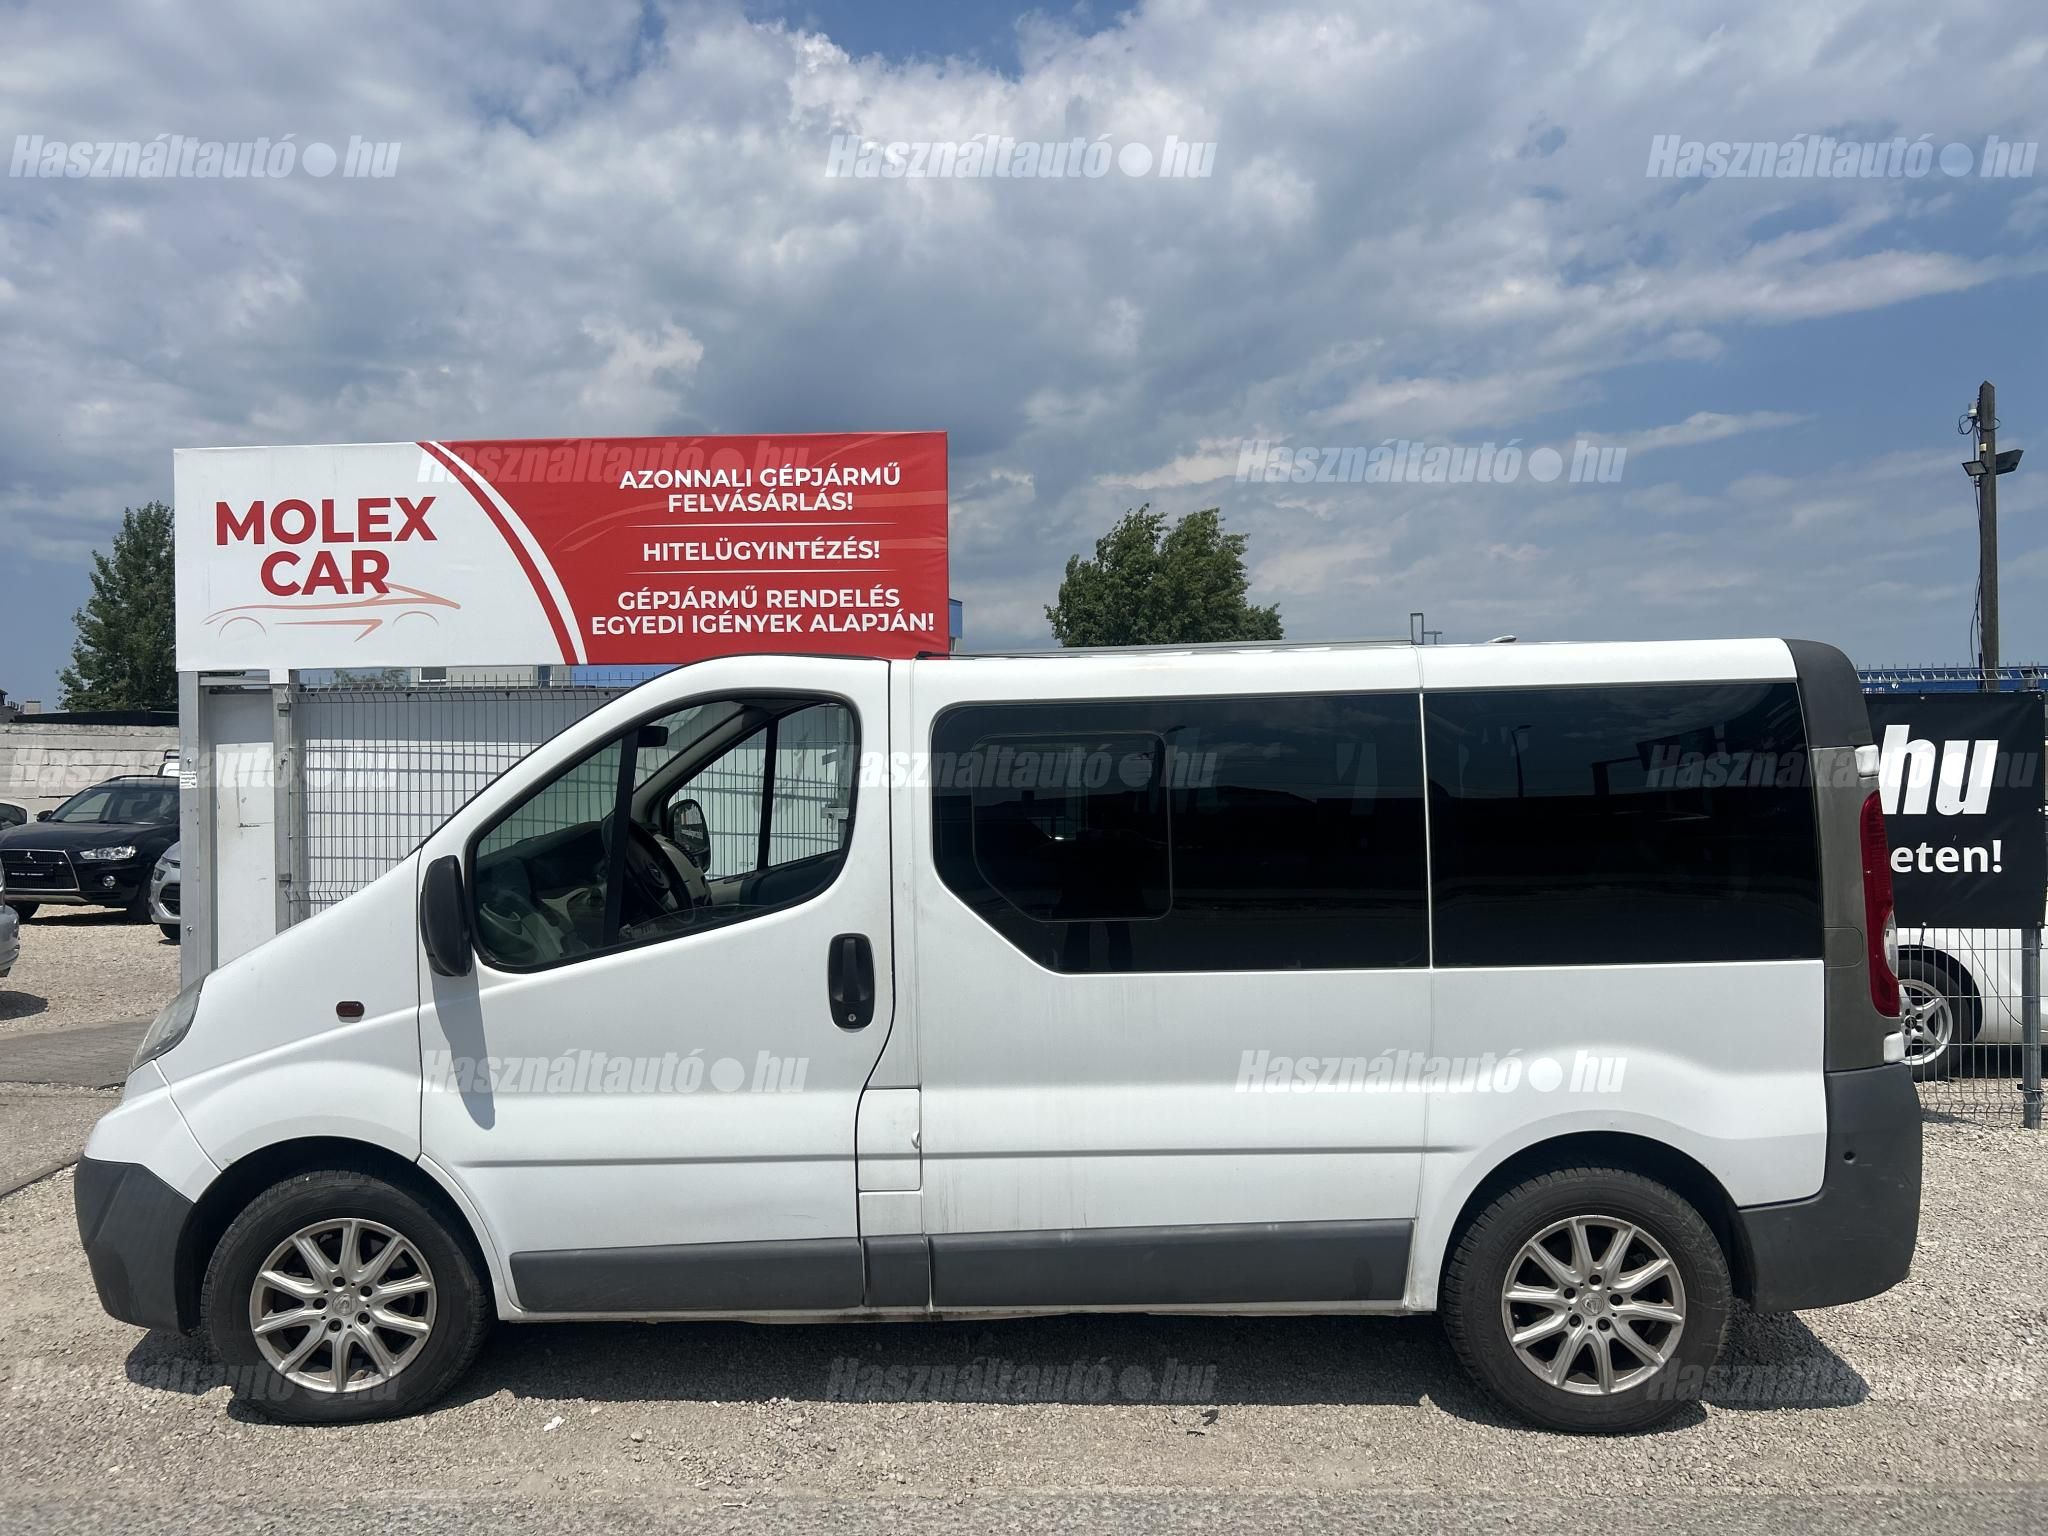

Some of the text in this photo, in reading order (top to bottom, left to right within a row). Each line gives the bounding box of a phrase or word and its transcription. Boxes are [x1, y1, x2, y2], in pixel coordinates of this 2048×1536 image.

[619, 463, 901, 489] AZONNALI GÉPJÁRMŰ
[668, 488, 854, 513] FELVÁSÁRLÁS!
[216, 496, 438, 545] MOLEX
[643, 536, 880, 561] HITELÜGYINTÉZÉS!
[260, 549, 390, 596] CAR
[617, 584, 900, 611] GÉPJÁRMŰ RENDELÉS
[592, 608, 935, 635] EGYEDI IGÉNYEK ALAPJÁN!
[1878, 724, 1999, 816] hu
[1891, 839, 2003, 873] eten!
